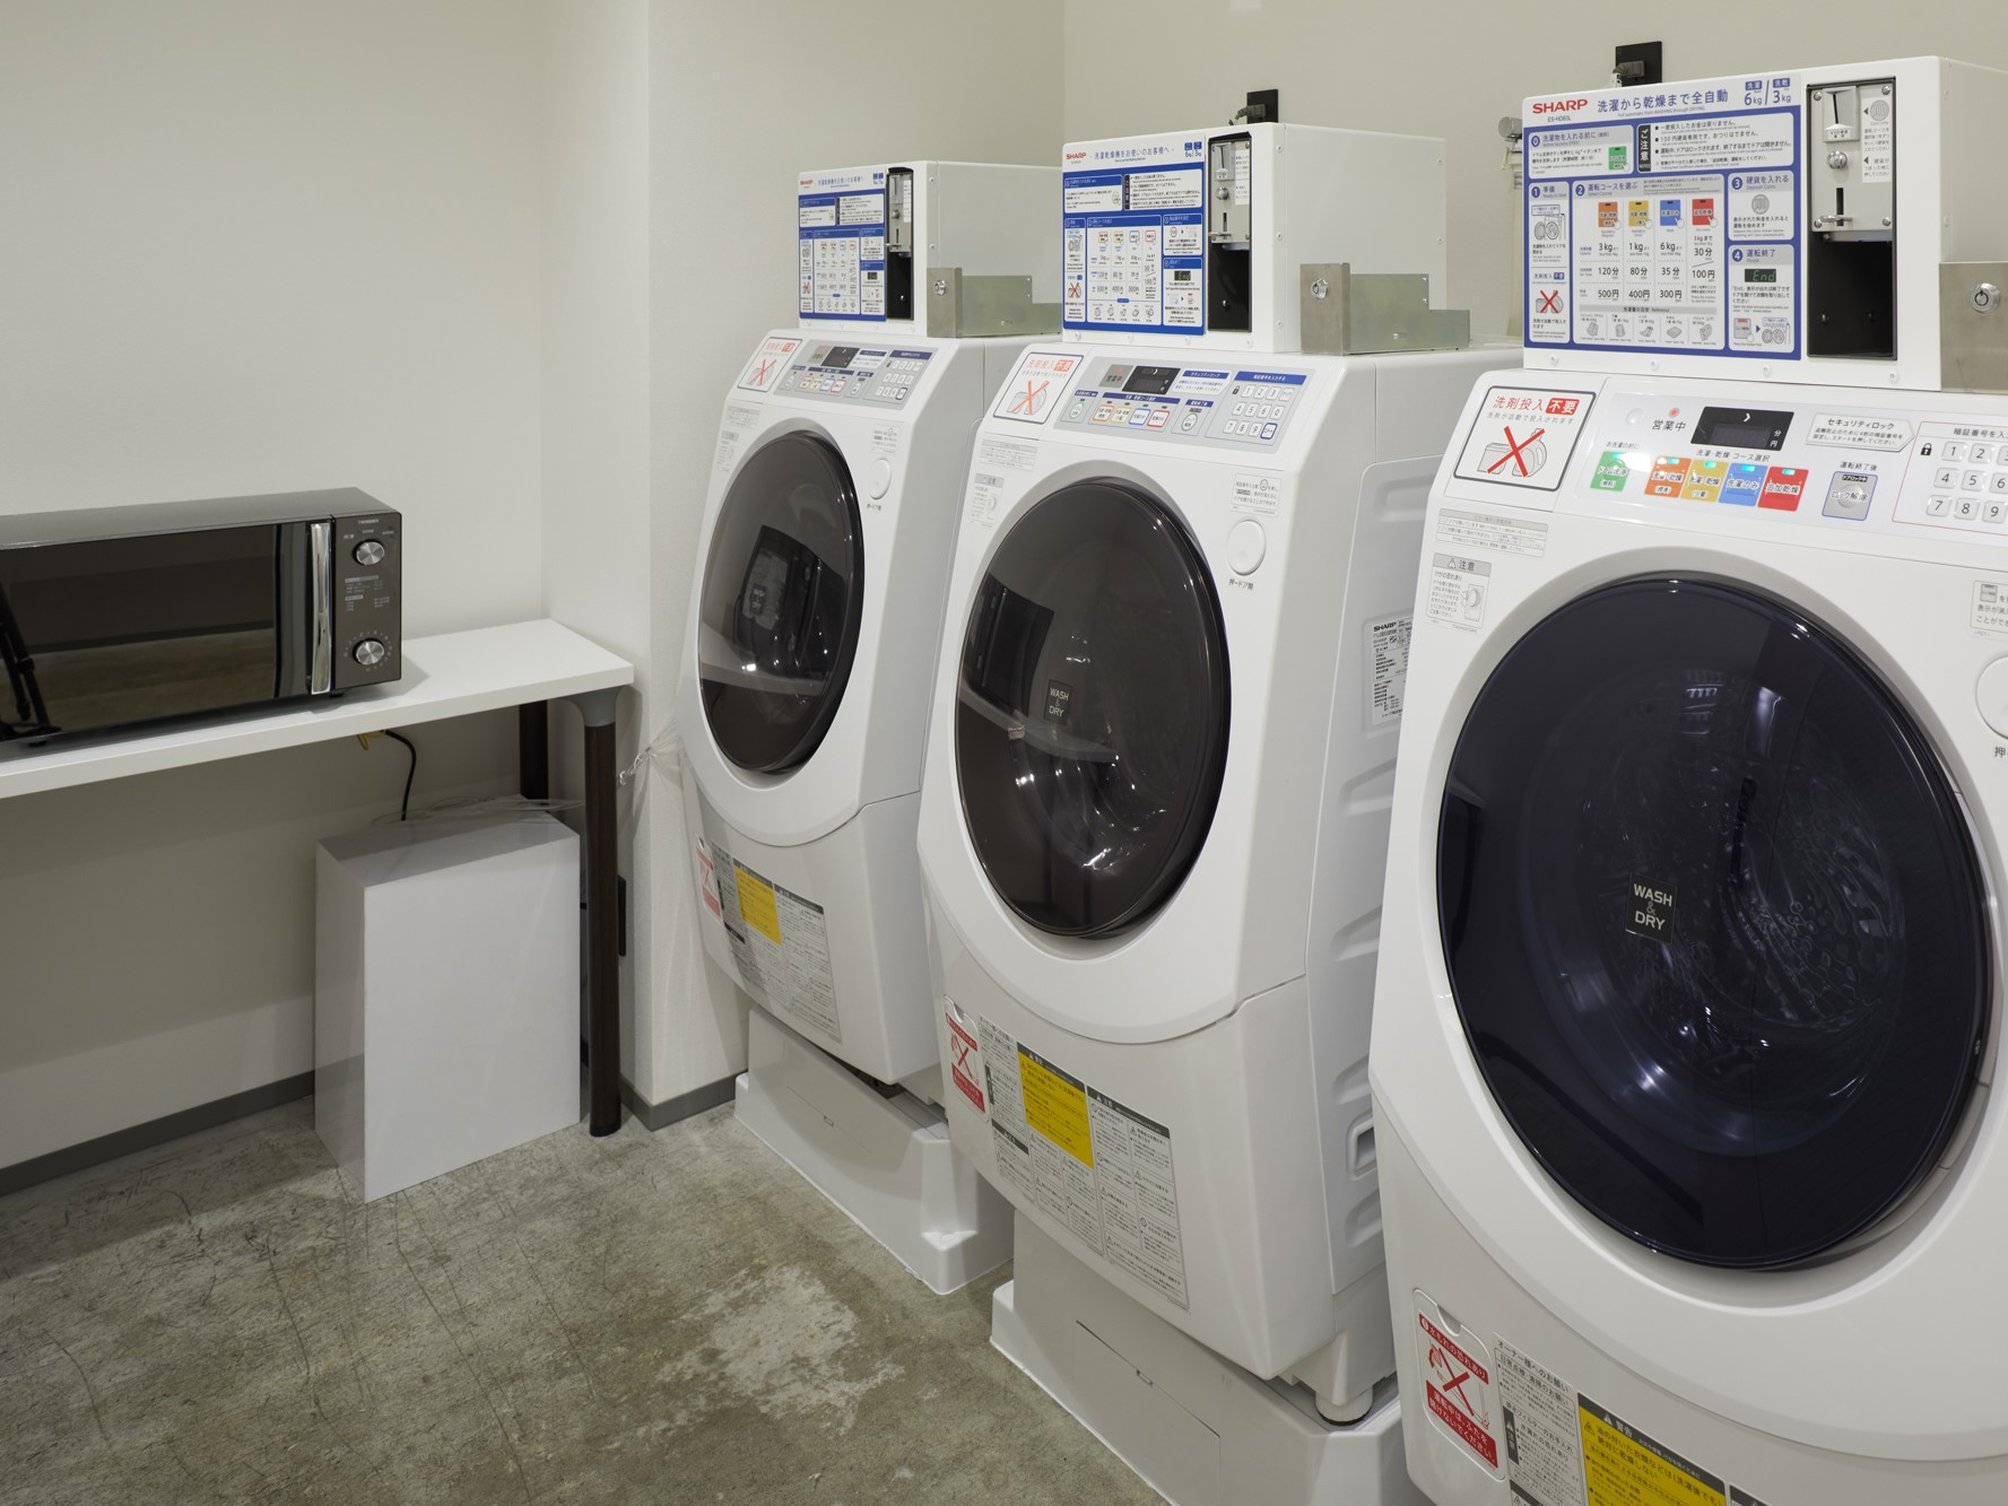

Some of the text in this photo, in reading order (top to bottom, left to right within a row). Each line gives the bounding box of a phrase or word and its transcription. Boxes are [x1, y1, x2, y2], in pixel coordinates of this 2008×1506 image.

[1532, 99, 1588, 114] SHARP
[1597, 89, 1729, 113] 洗濯から乾燥まで全自動
[1066, 152, 1087, 160] SHARP
[1598, 267, 1619, 276] 120分
[1630, 267, 1647, 276] 80分
[1661, 267, 1680, 276] 35分
[1692, 269, 1715, 279] 100円
[1598, 289, 1619, 298] 500円
[1628, 289, 1650, 299] 400円
[1660, 289, 1682, 299] 300円
[1493, 396, 1576, 414] 洗剤投入 不要
[1652, 420, 1686, 432] 営業中
[1828, 418, 1895, 430] セキュリティロック
[1951, 446, 1957, 457] 1
[1976, 448, 1985, 459] 2
[1840, 461, 1878, 471] 運転終了後
[1941, 473, 1950, 483] 4
[1969, 474, 1977, 485] 5
[1997, 478, 2006, 488] 6
[1935, 500, 1943, 511] 7
[1961, 503, 1971, 514] 8
[1990, 506, 1999, 517] 9
[1051, 687, 1069, 701] WASH
[1049, 705, 1064, 717] DRY
[1634, 883, 1673, 907] WASH
[1646, 901, 1656, 915] &
[1634, 910, 1666, 930] DRY
